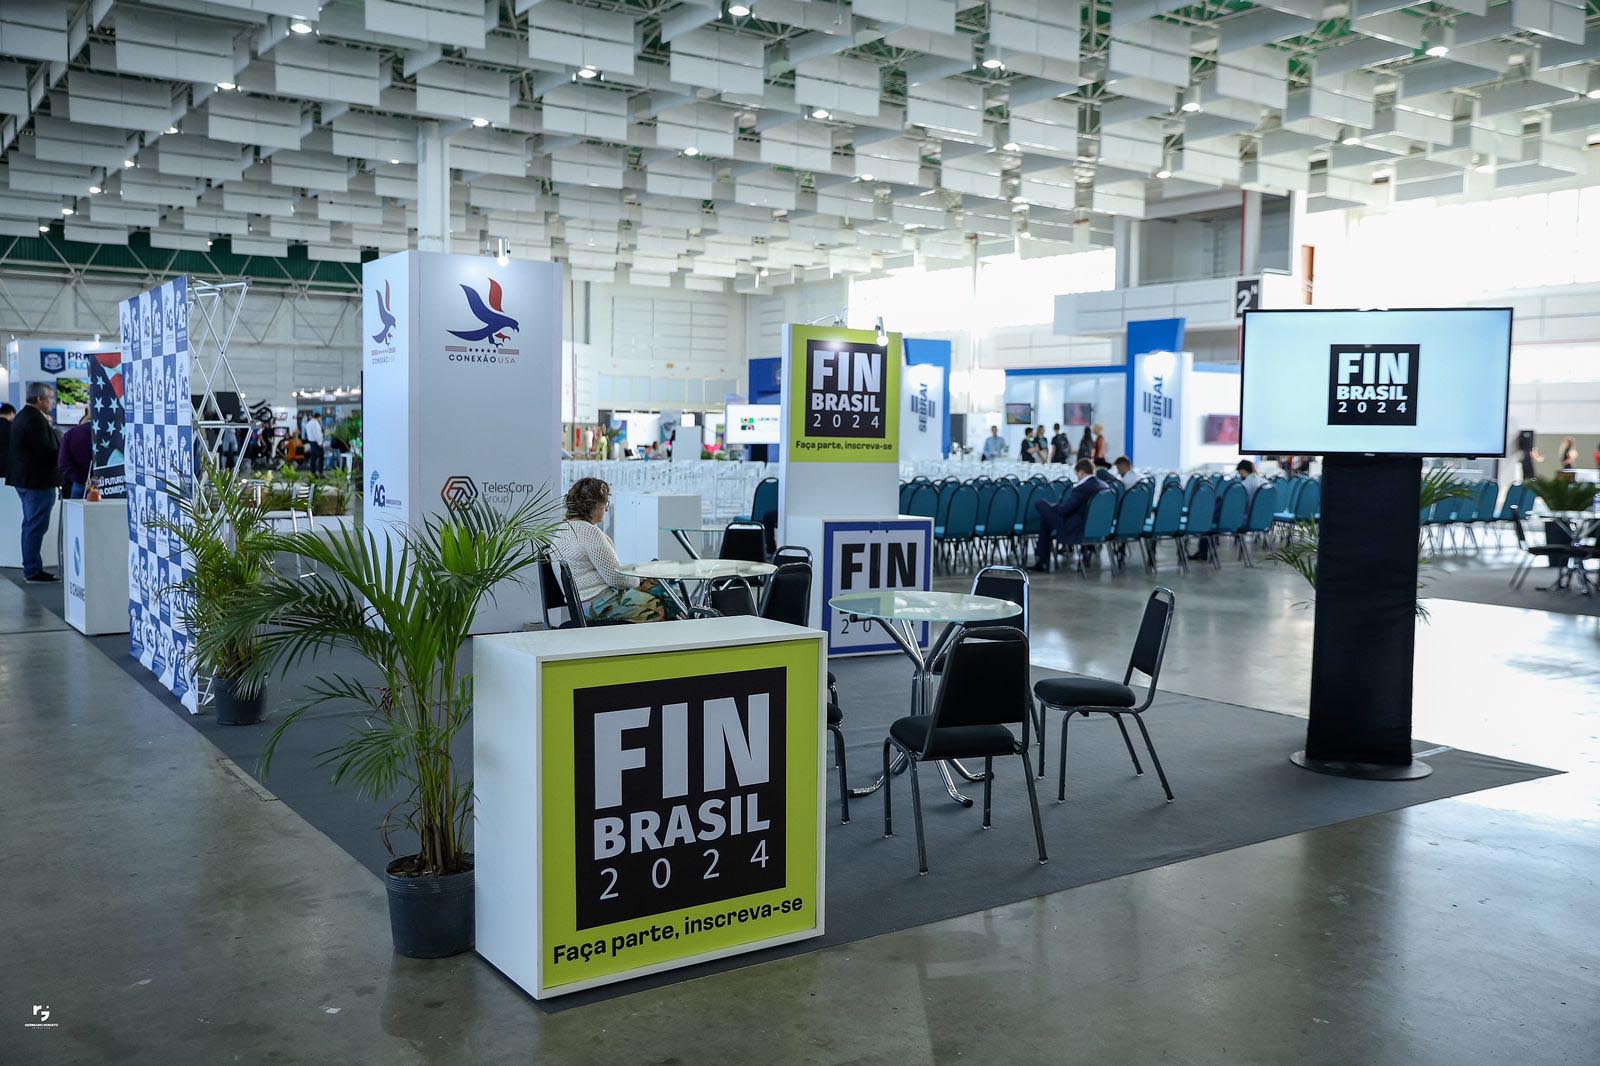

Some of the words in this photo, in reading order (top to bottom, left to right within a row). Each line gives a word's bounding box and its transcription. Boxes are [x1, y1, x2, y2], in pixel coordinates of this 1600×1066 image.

[448, 354, 497, 363] CONEXÃO
[813, 350, 881, 392] FIN
[1338, 353, 1409, 384] FIN
[812, 393, 880, 412] BRASIL
[1336, 386, 1408, 400] BRASIL
[795, 440, 816, 450] Faça
[817, 441, 844, 451] parte,
[844, 441, 893, 450] inscreva-se
[373, 484, 386, 507] AG
[481, 481, 534, 496] TelesCorp
[841, 542, 917, 590] FIN
[594, 692, 770, 810] FIN
[593, 793, 771, 861] BRASIL
[553, 939, 606, 965] Faça
[612, 924, 680, 957] parte,
[684, 897, 803, 935] inscreva-se
